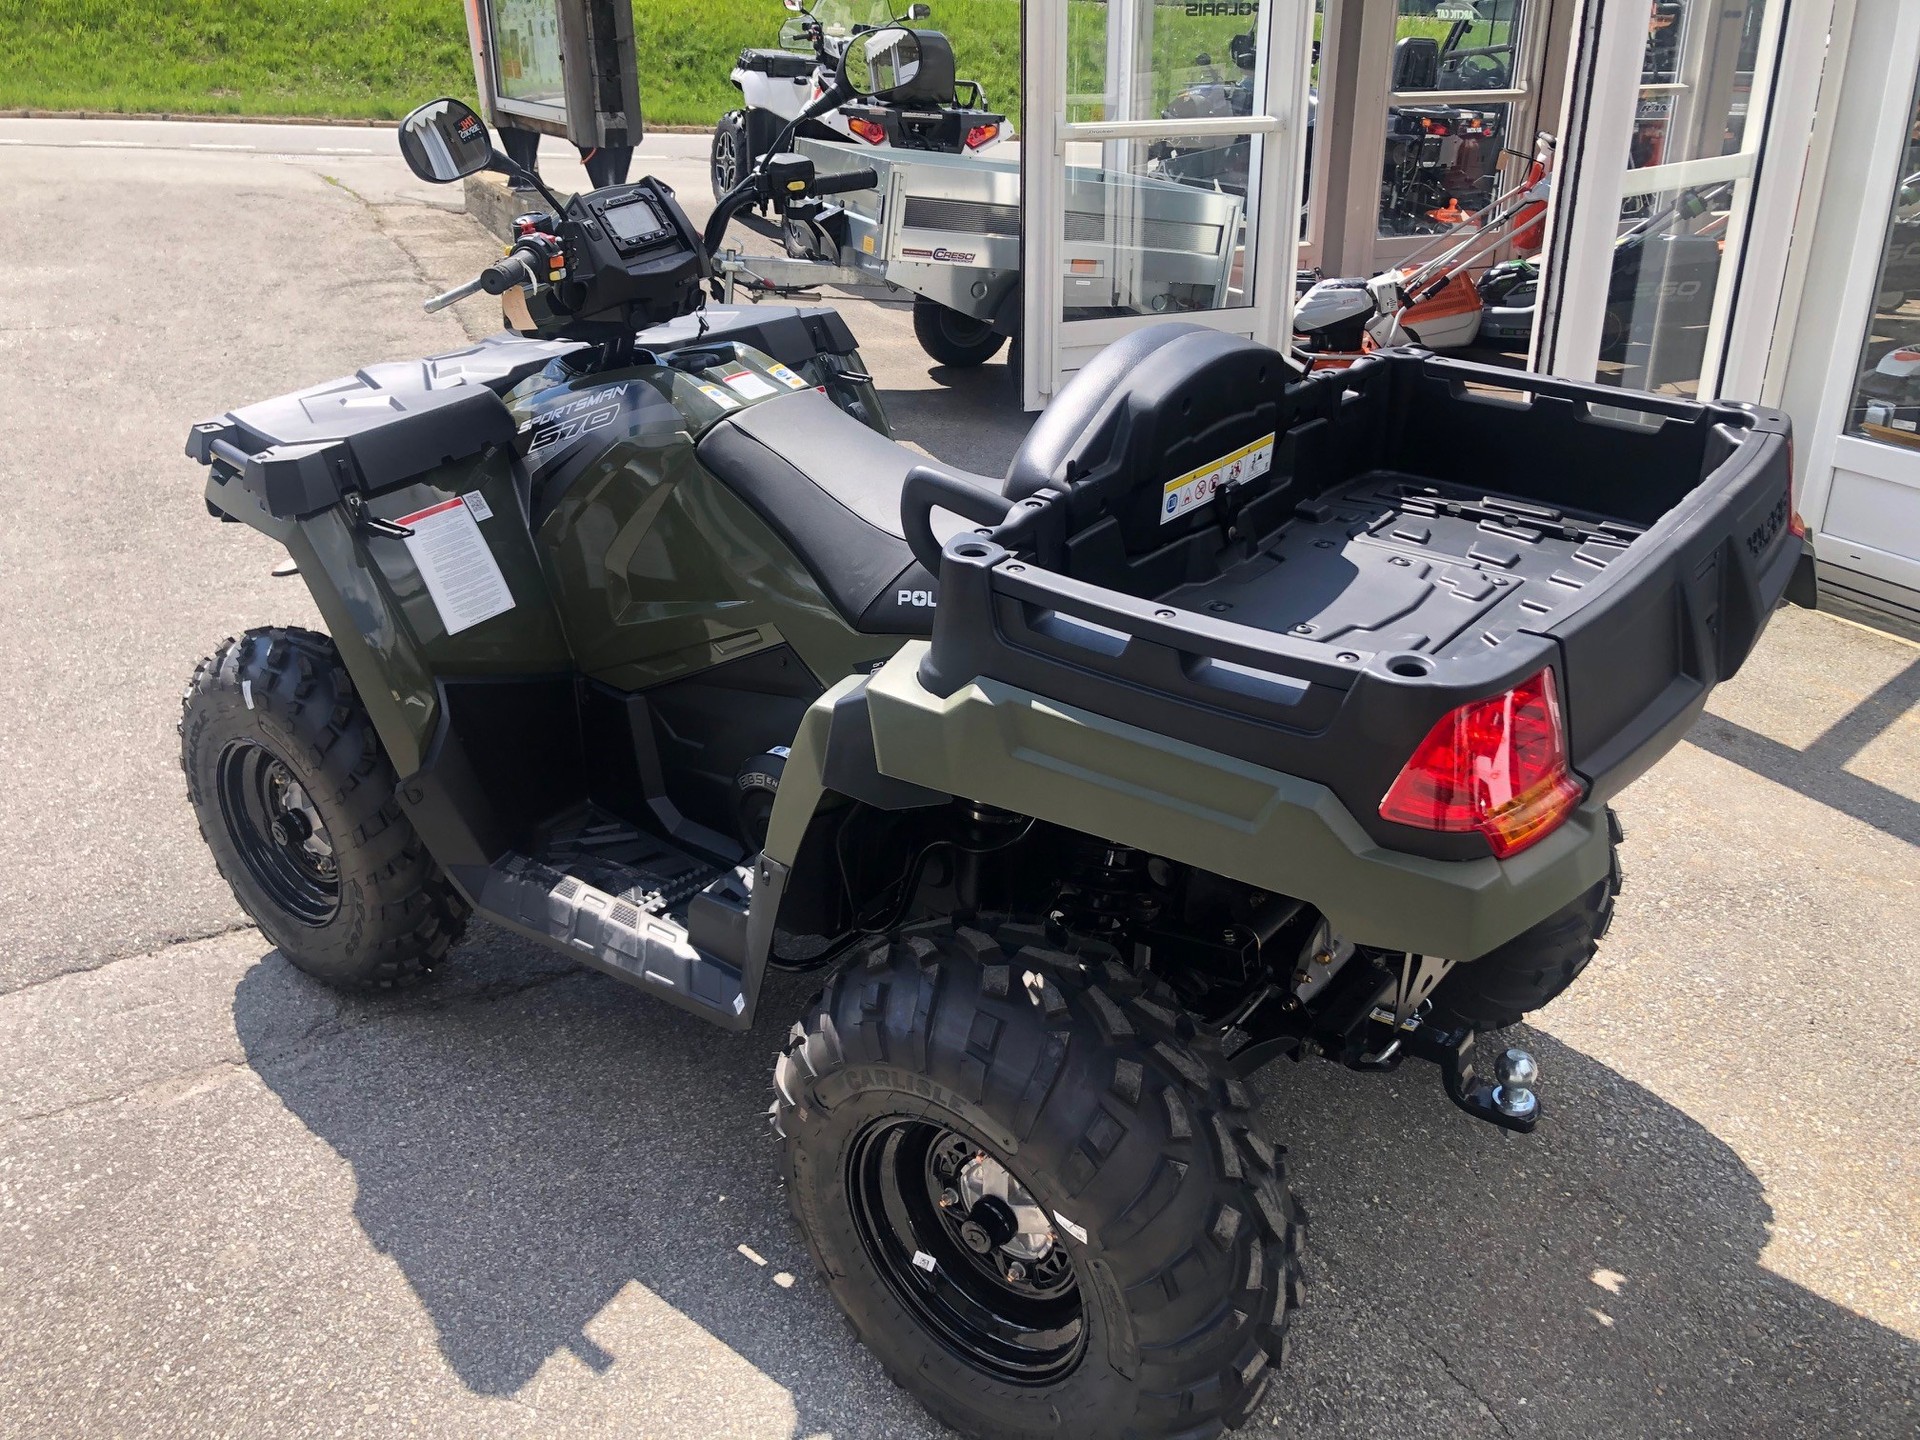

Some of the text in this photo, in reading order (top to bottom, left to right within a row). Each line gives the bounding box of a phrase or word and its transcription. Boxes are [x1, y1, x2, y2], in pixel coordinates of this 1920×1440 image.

[934, 249, 976, 261] CRESCI
[517, 383, 629, 435] SPORTSMAN
[527, 402, 620, 454] 570
